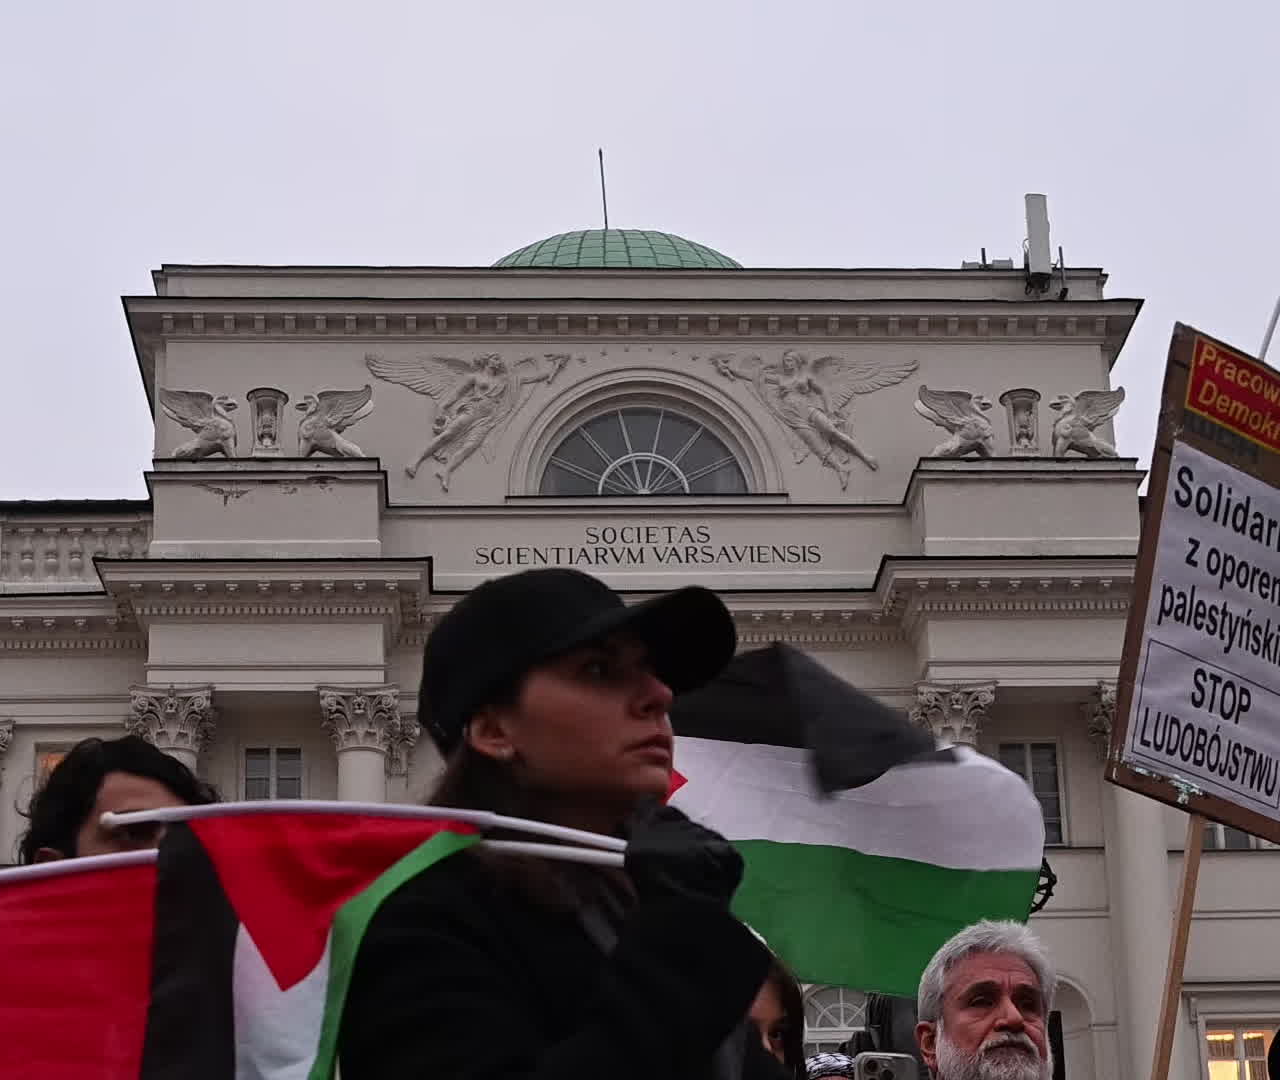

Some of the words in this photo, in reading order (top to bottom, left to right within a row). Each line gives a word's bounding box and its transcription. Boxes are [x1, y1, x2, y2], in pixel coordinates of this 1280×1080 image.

[585, 525, 711, 544] SOCIETAS
[474, 546, 645, 566] SCIENTIARVM
[652, 544, 822, 564] VARSAVIENSIS
[1185, 537, 1201, 568] z
[1191, 667, 1252, 725] STOP
[1139, 706, 1280, 797] LUDOBÓJSTWU
